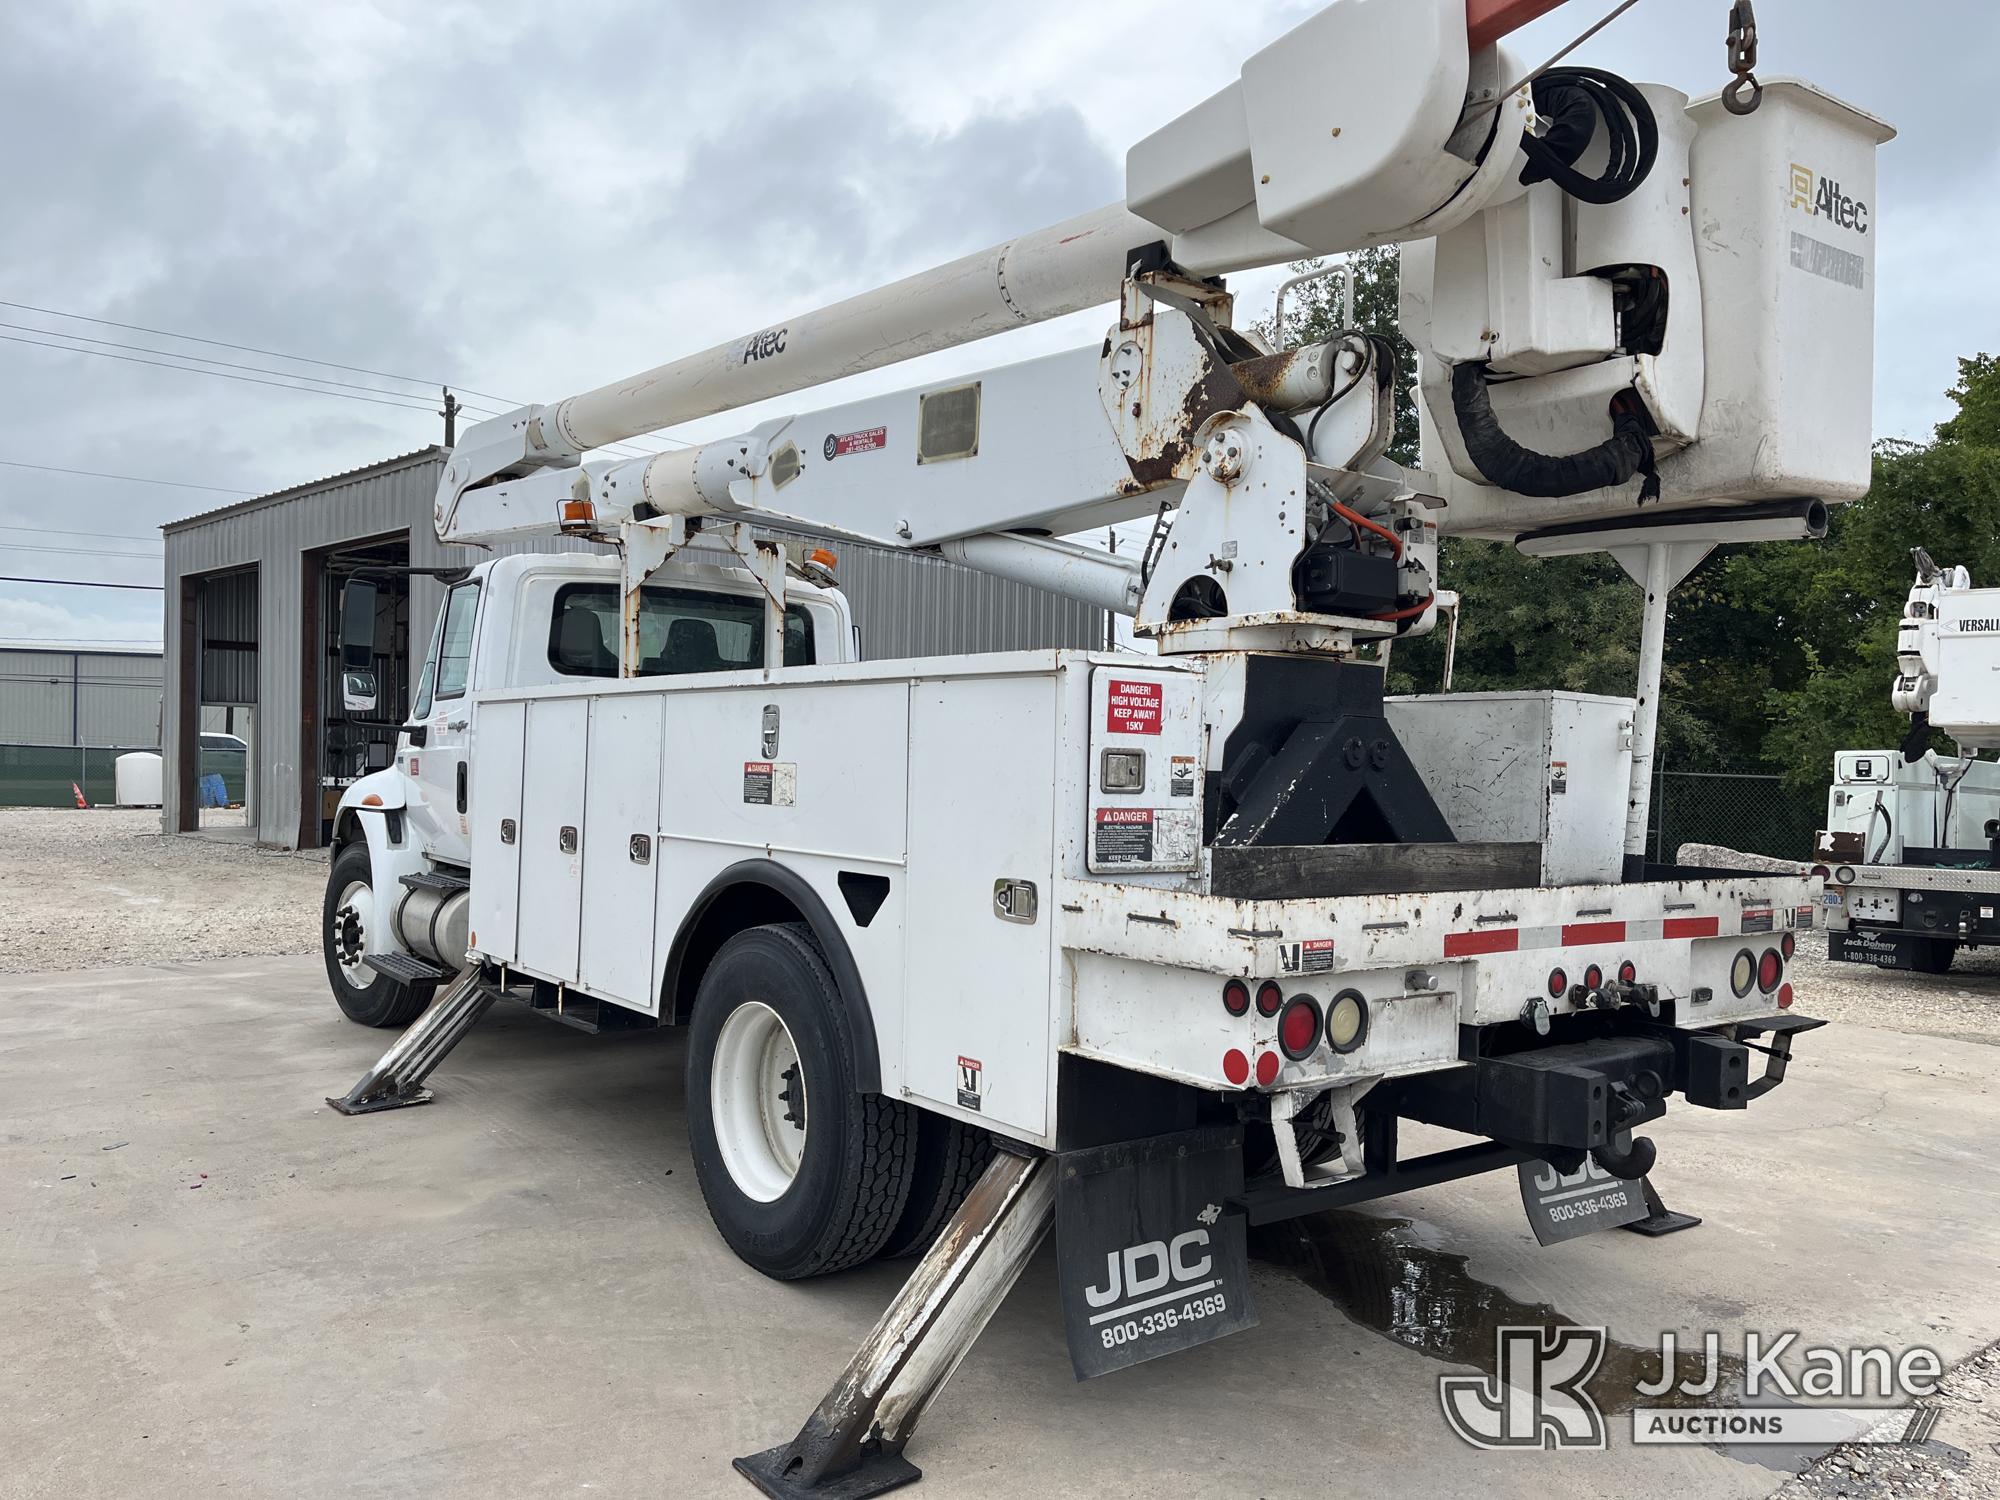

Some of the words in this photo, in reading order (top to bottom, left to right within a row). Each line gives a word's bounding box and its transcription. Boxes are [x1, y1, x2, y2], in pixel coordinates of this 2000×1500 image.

[1813, 176, 1868, 234] Altec
[743, 328, 788, 365] Altec
[1959, 619, 2000, 631] VERSALI
[1120, 683, 1152, 696] DANGER!
[1111, 695, 1129, 706] HIGH
[1129, 696, 1160, 708] VOLTAGE
[1113, 707, 1132, 719] KEEP
[1132, 709, 1156, 720] AWAY!
[1125, 720, 1144, 731] 15KV
[1113, 811, 1148, 821] DANGER
[1843, 938, 1863, 947] Jack
[1548, 1191, 1628, 1223] 800-336-4369
[1085, 1228, 1212, 1308] JDC
[1101, 1293, 1227, 1349] 800-336-4369
